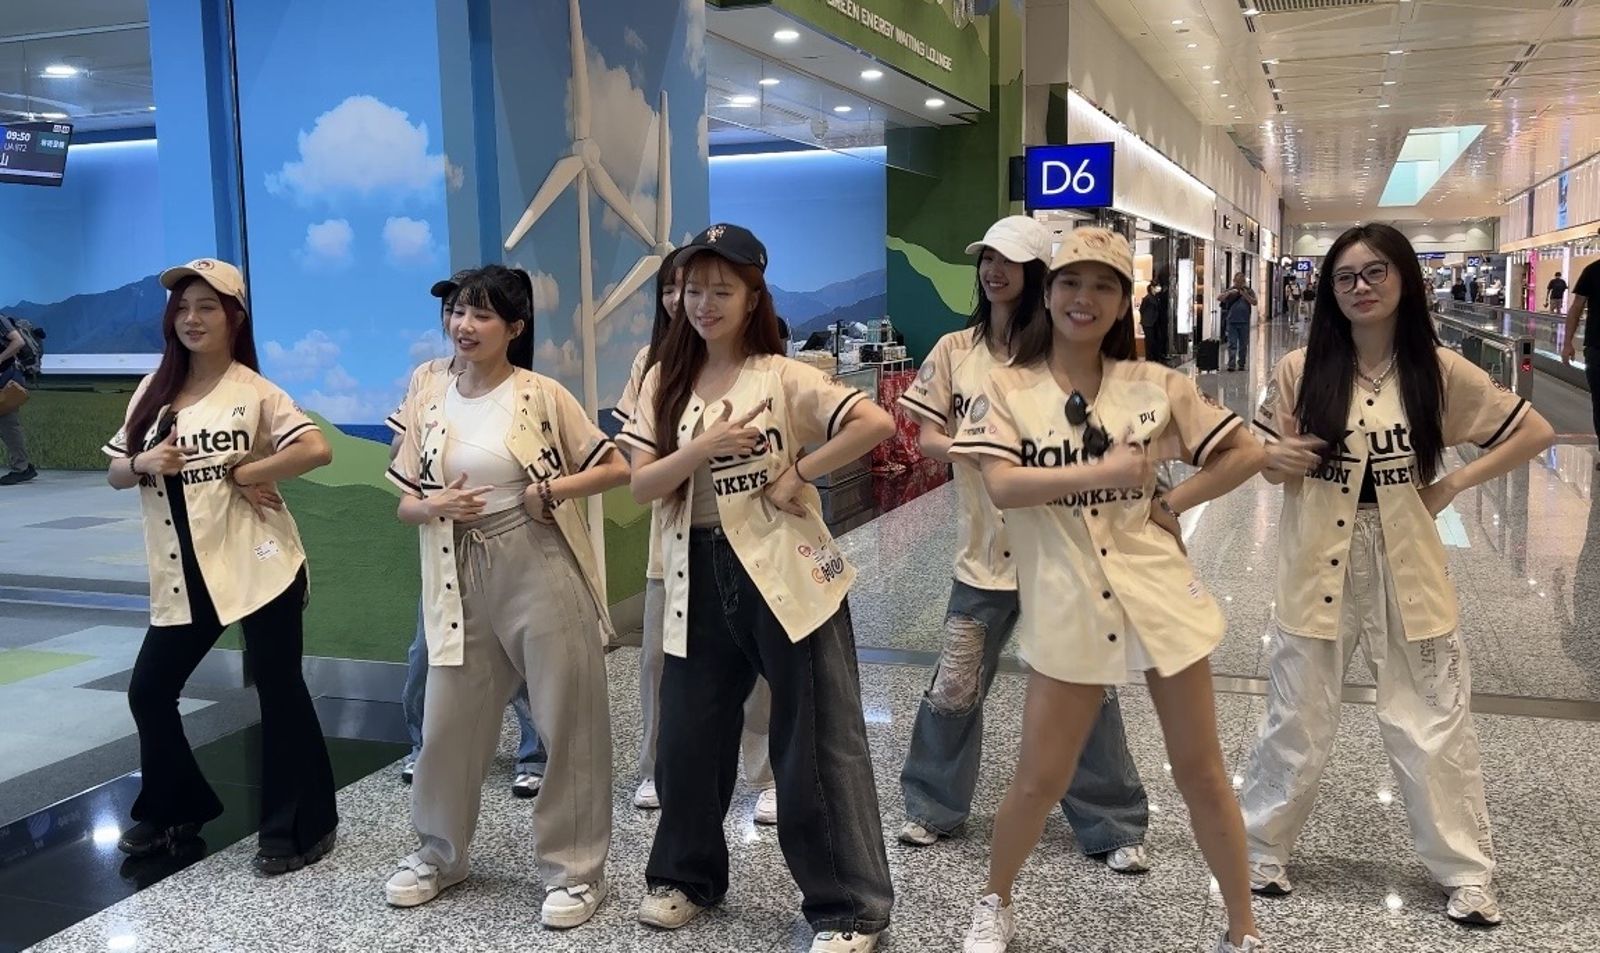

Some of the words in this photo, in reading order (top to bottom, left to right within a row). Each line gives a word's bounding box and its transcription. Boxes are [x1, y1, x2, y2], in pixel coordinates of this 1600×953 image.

[861, 7, 895, 38] ENERGY
[925, 45, 953, 71] LOUNGE
[6, 131, 31, 141] 09:50
[1042, 158, 1095, 195] D6
